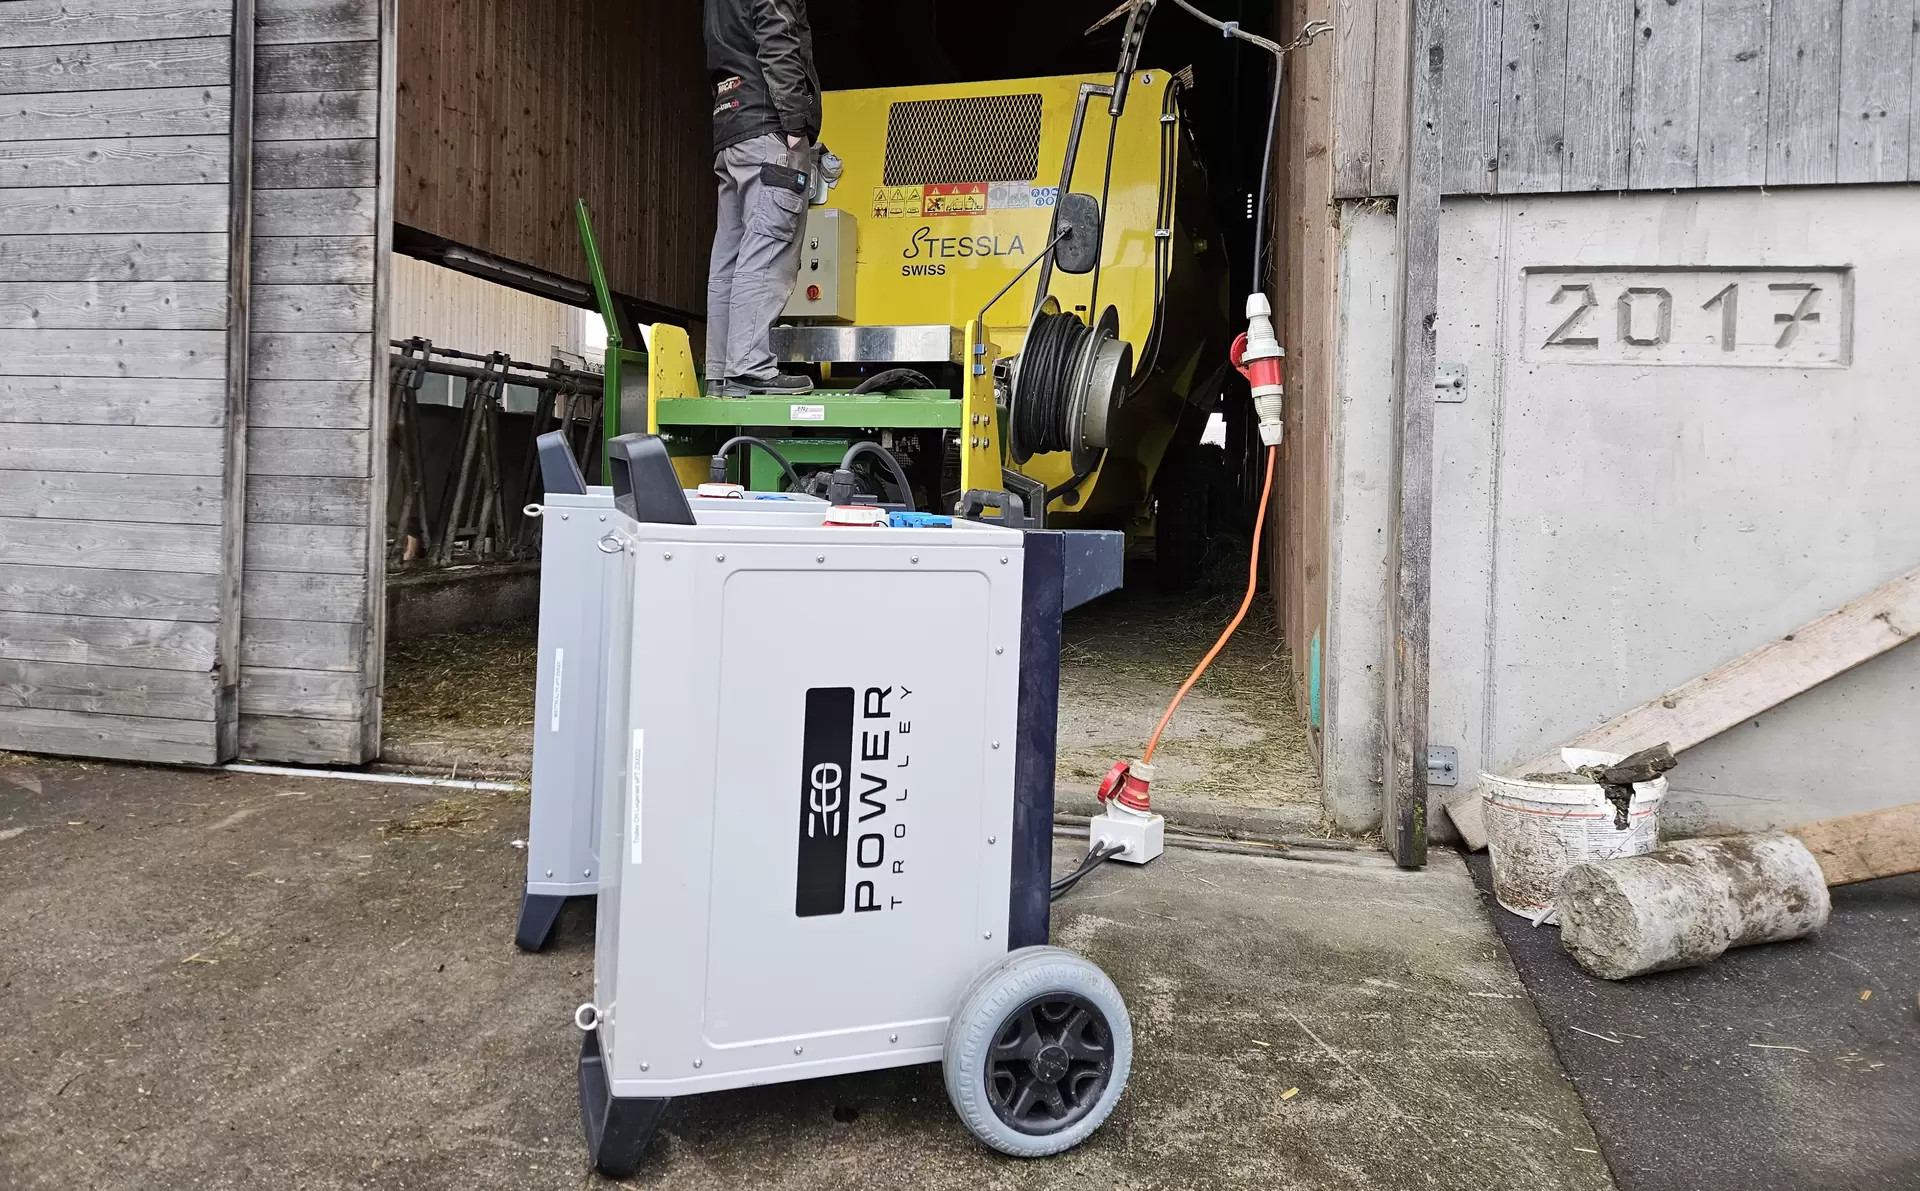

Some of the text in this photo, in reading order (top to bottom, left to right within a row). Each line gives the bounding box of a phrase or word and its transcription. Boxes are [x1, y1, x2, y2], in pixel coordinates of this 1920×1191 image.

[902, 264, 946, 276] SWISS
[903, 226, 1025, 259] STESSLA
[1541, 283, 1822, 351] 2017
[854, 685, 892, 913] POWER
[891, 685, 912, 910] TROLLEY
